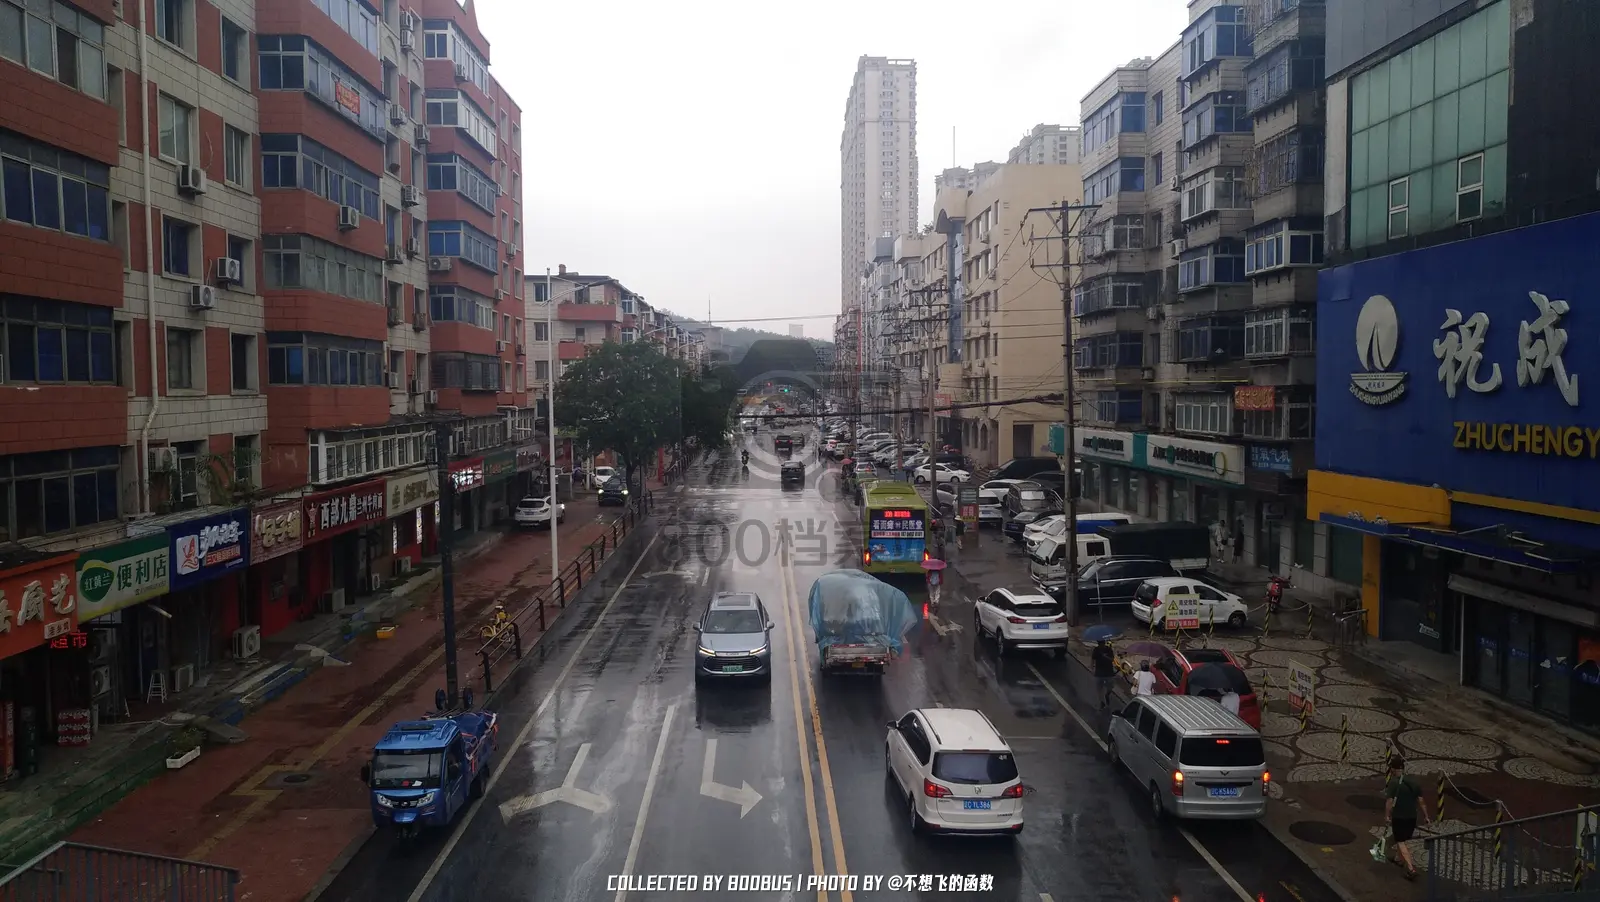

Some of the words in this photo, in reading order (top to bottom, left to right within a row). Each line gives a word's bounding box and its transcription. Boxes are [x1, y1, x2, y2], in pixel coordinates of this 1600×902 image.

[1433, 290, 1579, 406] 祝成
[116, 555, 167, 591] 便利店
[50, 630, 88, 649] 超市
